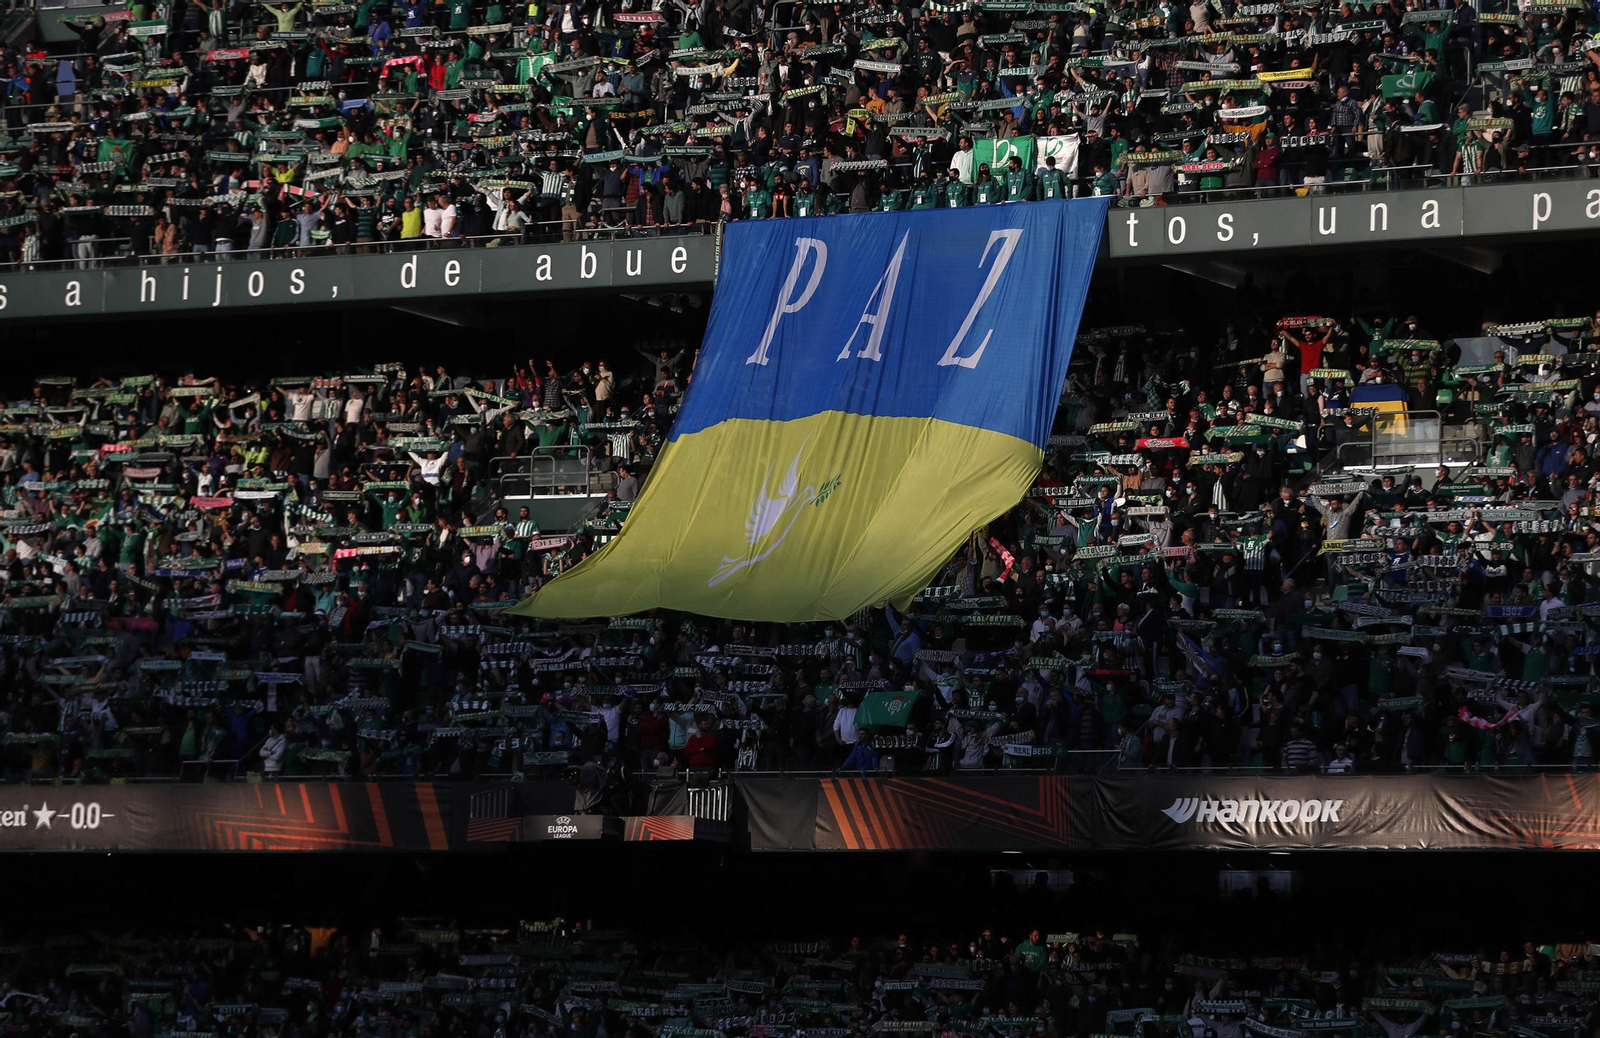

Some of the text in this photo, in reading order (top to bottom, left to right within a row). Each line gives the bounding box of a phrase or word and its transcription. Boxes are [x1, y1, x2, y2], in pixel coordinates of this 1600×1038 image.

[1283, 135, 1324, 147] REAL BETIS
[66, 280, 82, 307] a
[401, 254, 461, 289] de
[1318, 199, 1441, 235] una
[1532, 188, 1600, 231] pa
[745, 227, 1023, 369] PAZ
[1502, 607, 1523, 617] 1907
[970, 614, 1011, 623] REAL BETIS
[1049, 656, 1061, 664] BET
[1013, 746, 1052, 756] REAL BETIS
[547, 825, 578, 834] EUROPA
[1229, 988, 1261, 997] Real Betis
